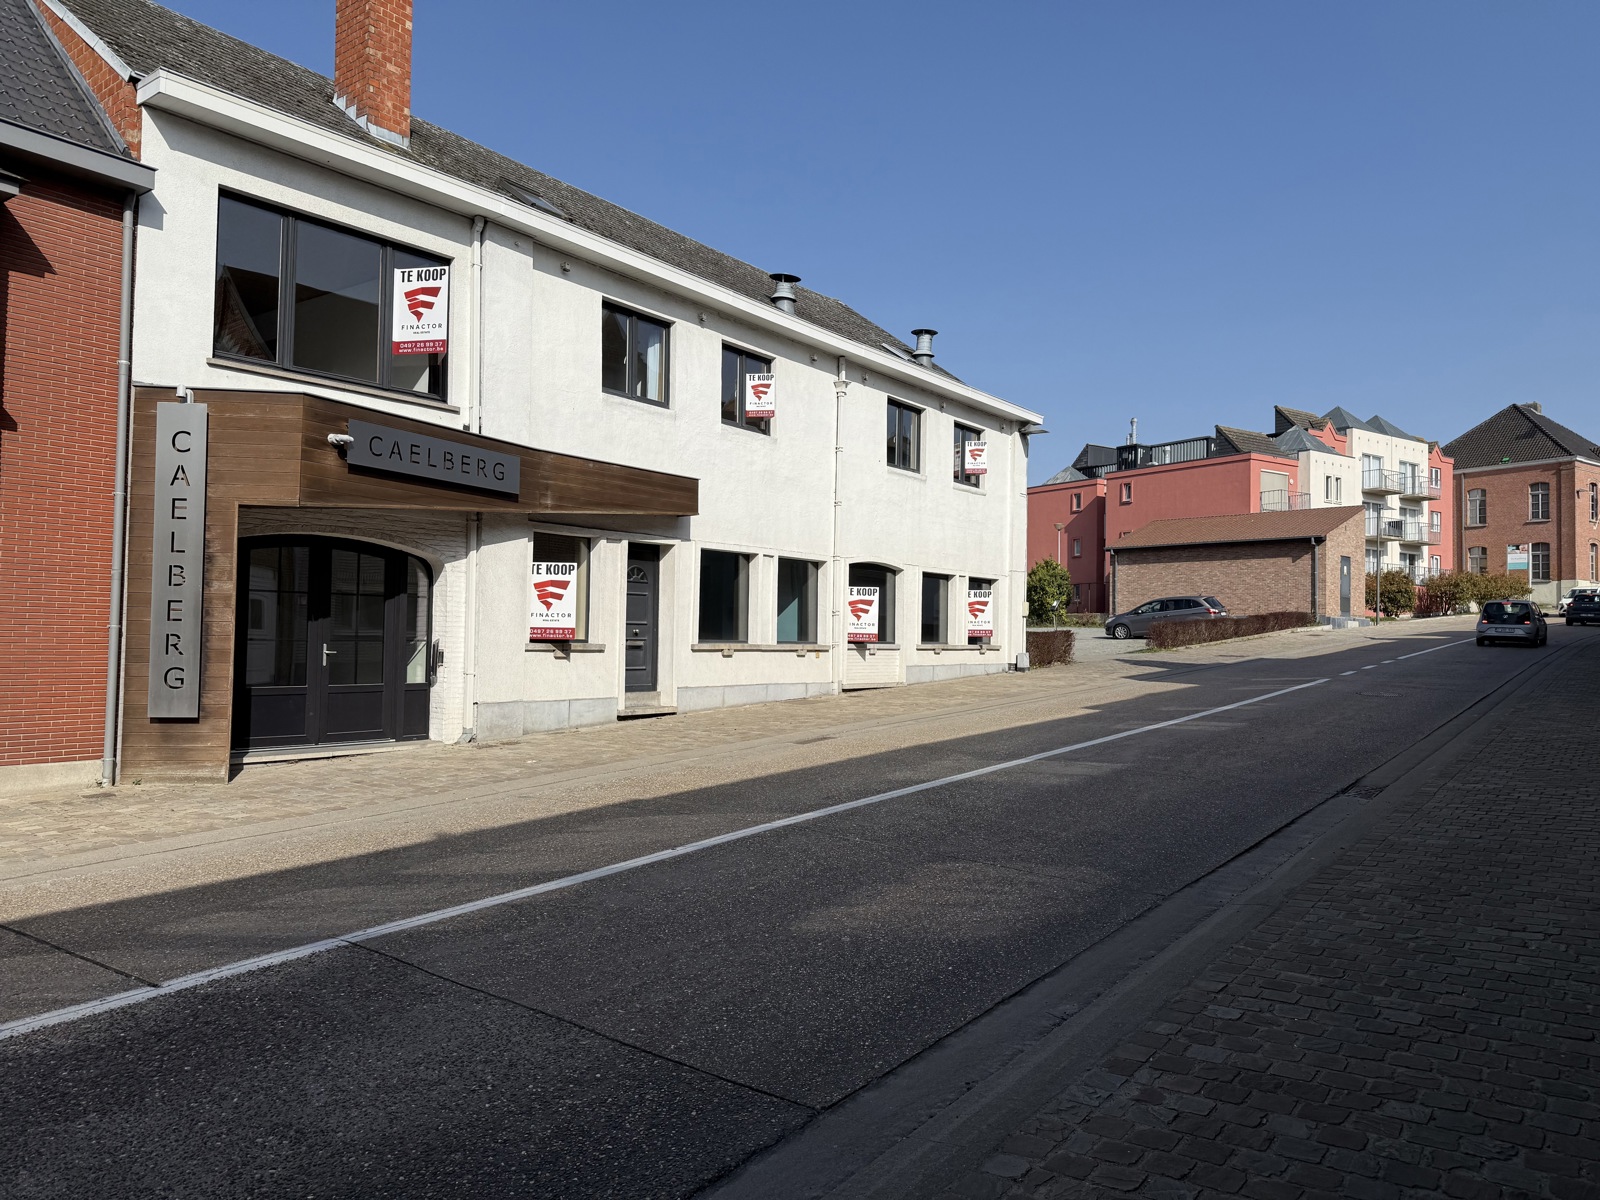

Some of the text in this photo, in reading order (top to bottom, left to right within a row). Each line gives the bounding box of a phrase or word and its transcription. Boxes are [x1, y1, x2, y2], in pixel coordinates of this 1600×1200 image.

[400, 268, 446, 282] TE KOOP
[369, 436, 505, 481] CAELBERG
[163, 430, 191, 690] CAELBERG
[546, 564, 575, 575] KOOP
[857, 588, 877, 596] KOOP
